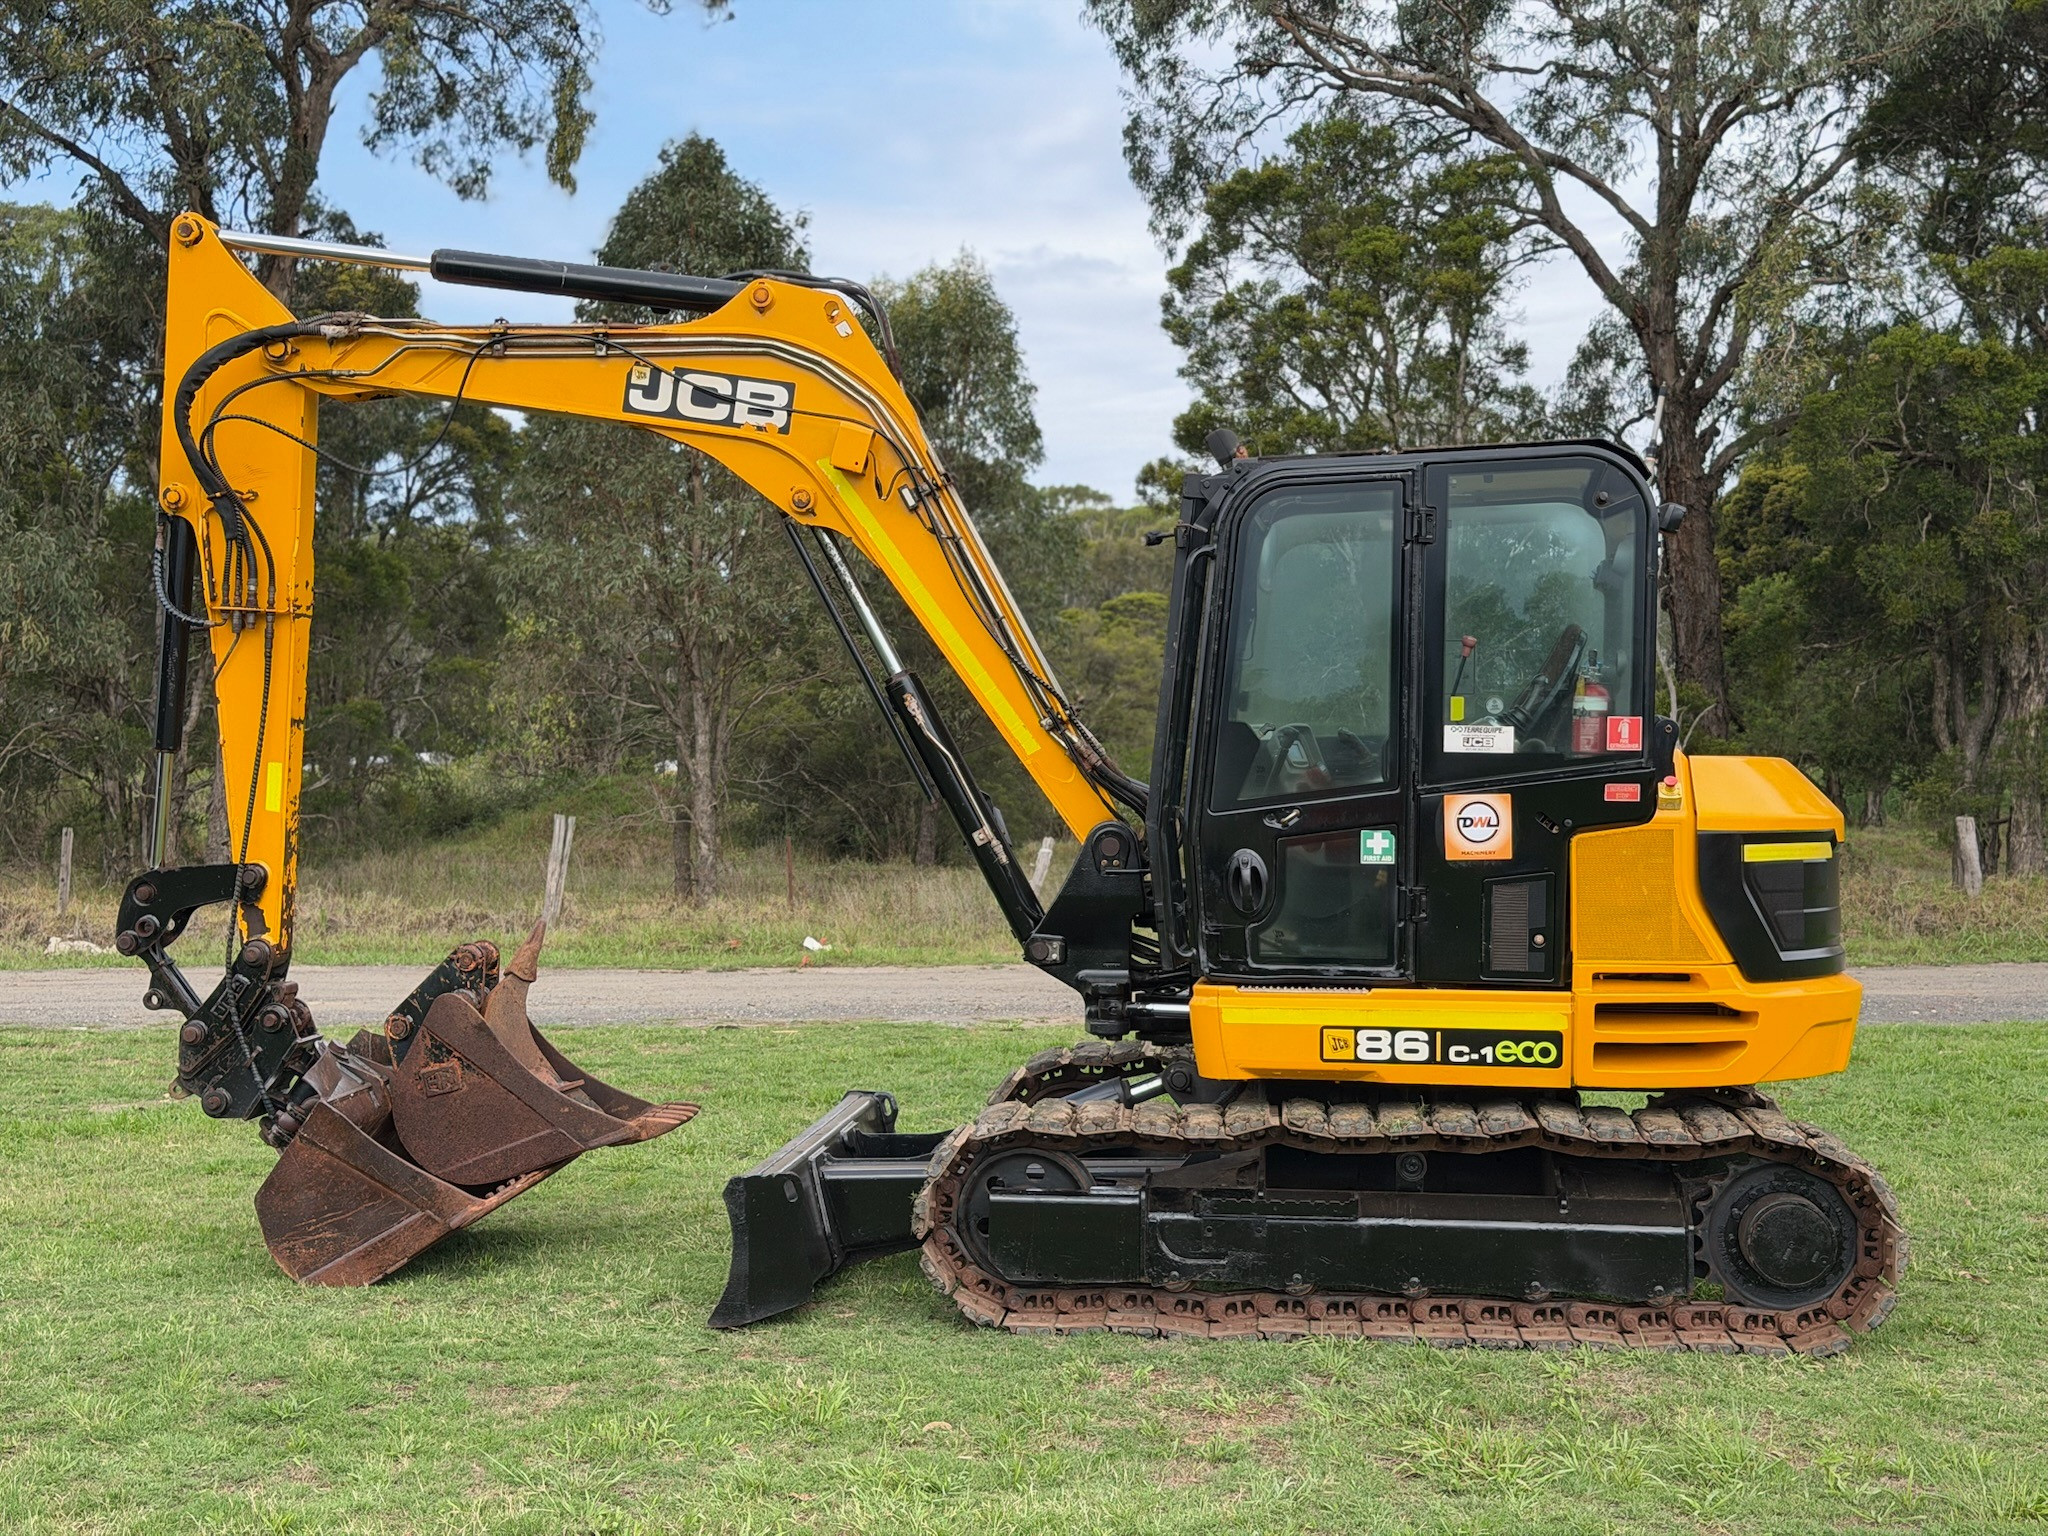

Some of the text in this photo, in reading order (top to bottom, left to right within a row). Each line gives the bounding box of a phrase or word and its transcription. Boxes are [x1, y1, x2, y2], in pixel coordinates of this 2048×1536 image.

[629, 370, 789, 428] JCB
[1463, 737, 1493, 747] JCB
[1457, 816, 1499, 828] DWL
[1330, 1036, 1350, 1053] JCB
[1356, 1029, 1430, 1062] 86
